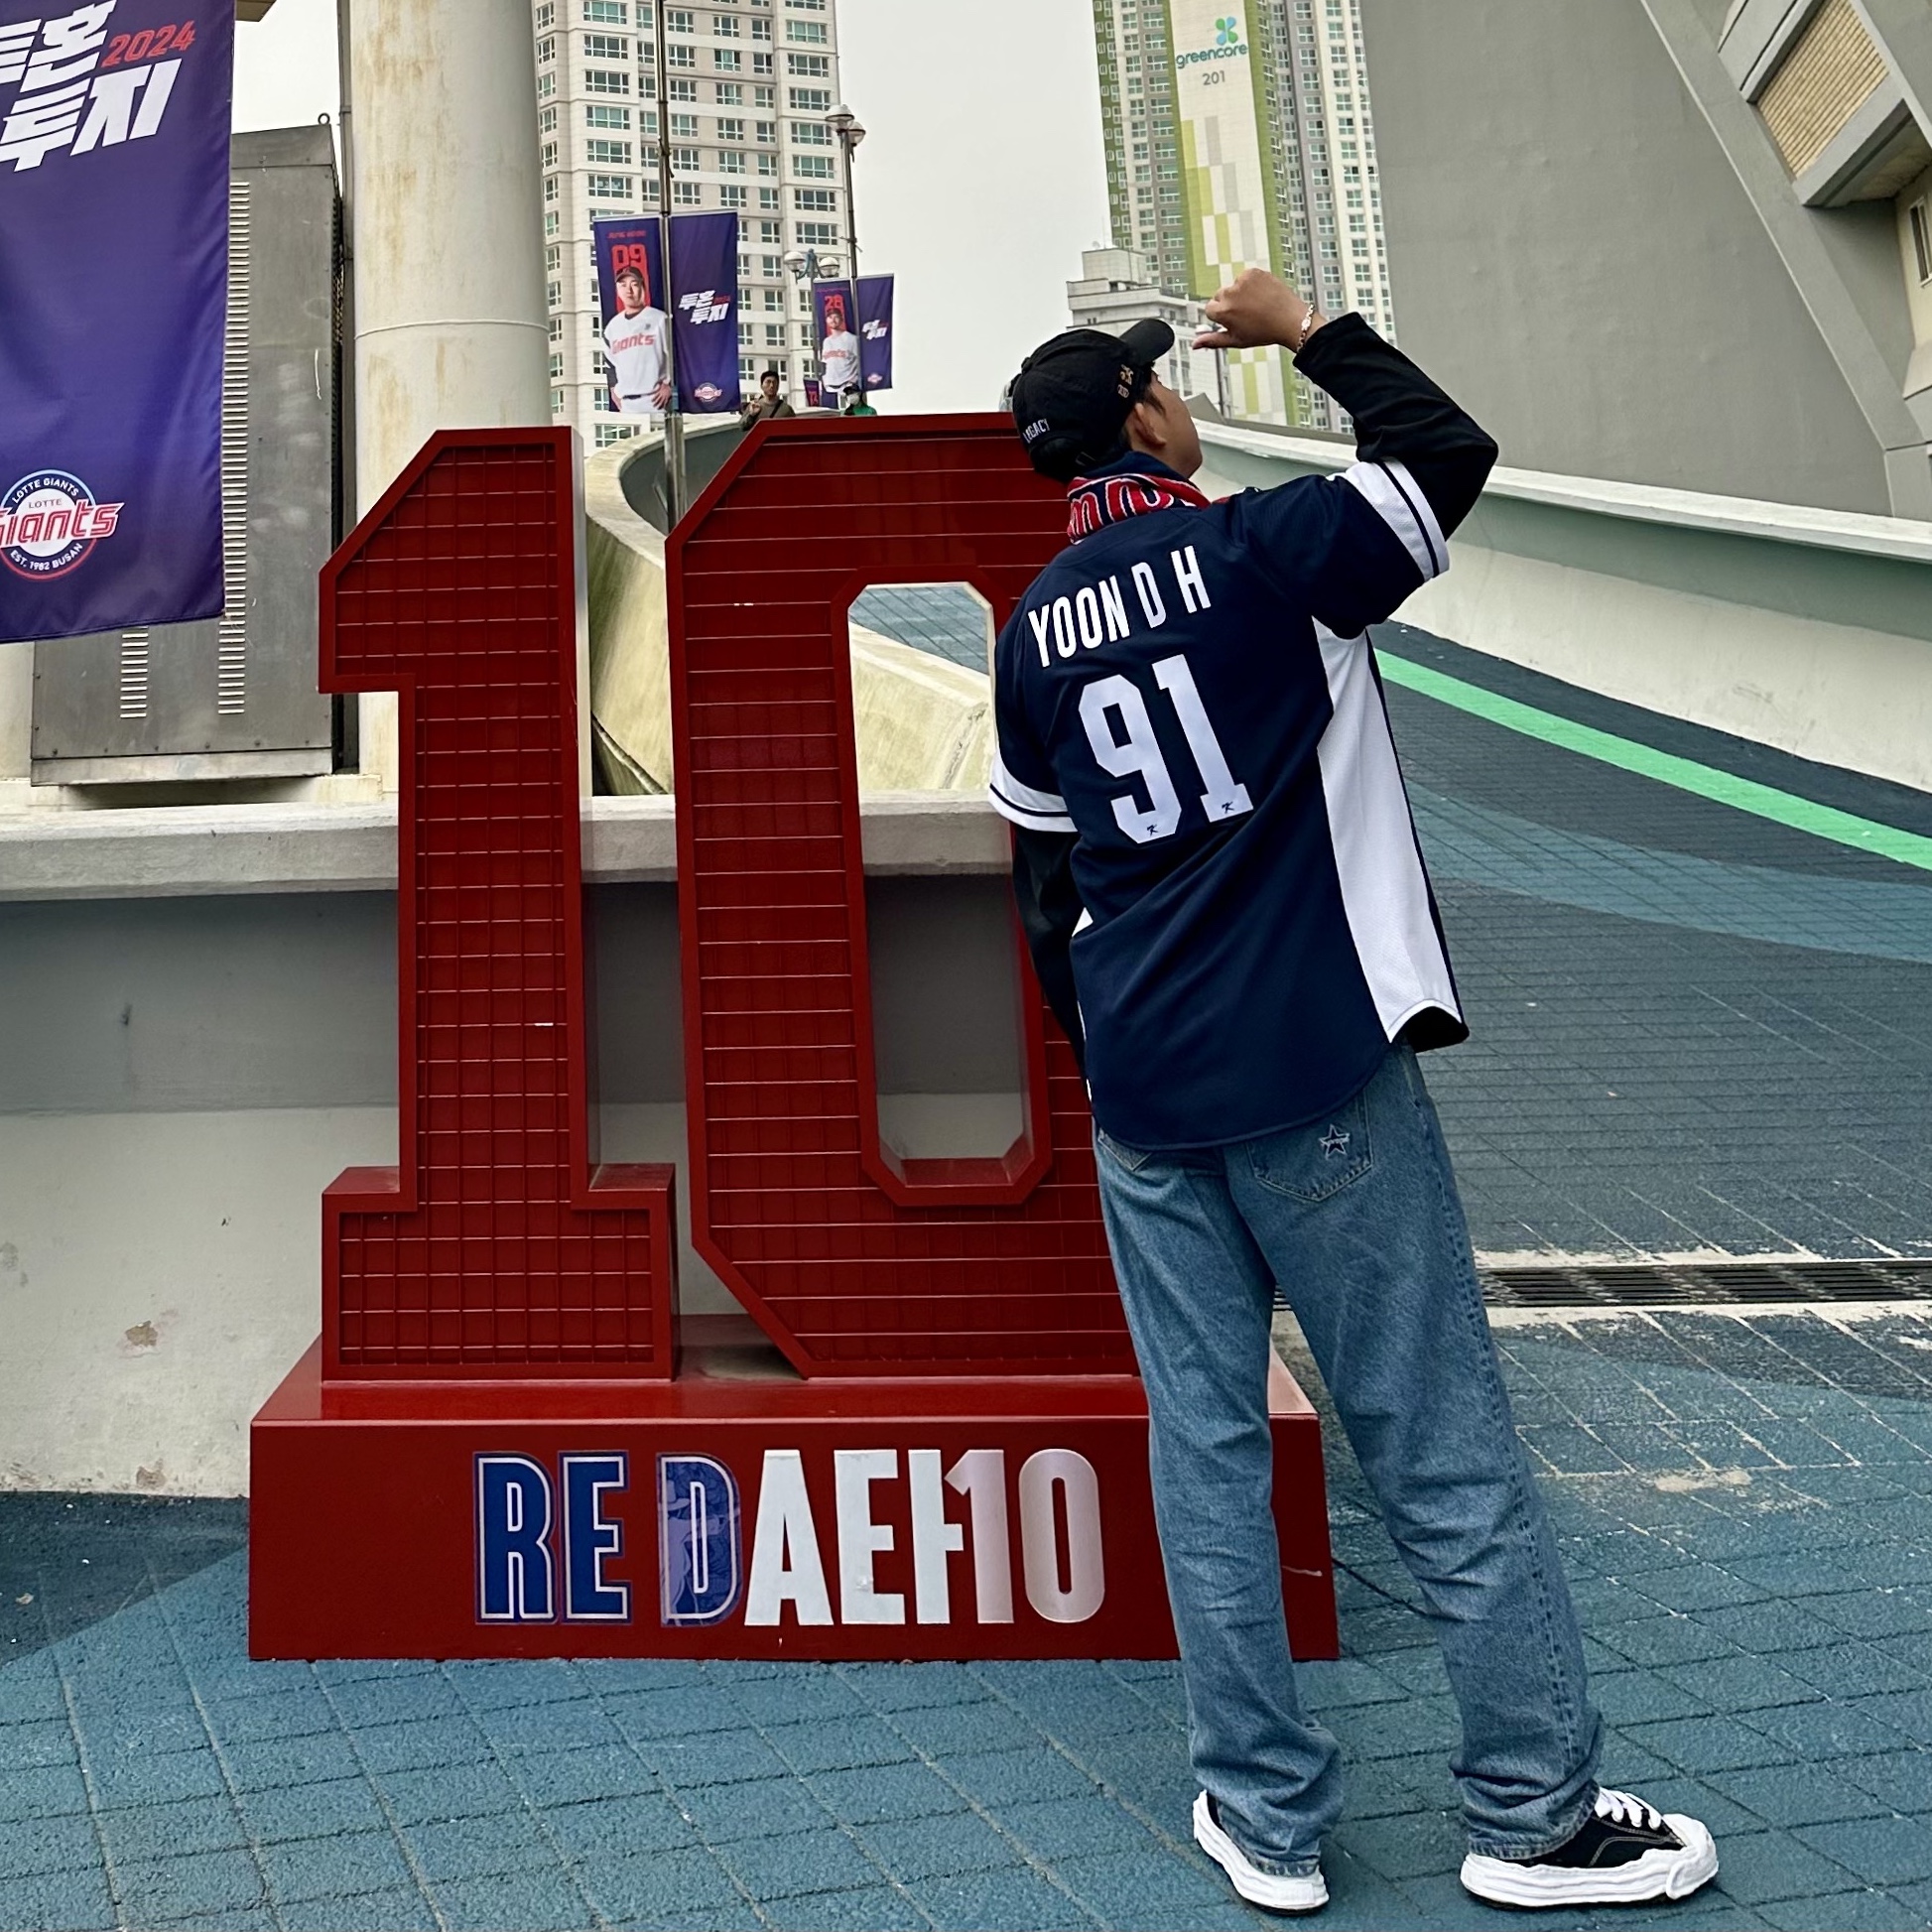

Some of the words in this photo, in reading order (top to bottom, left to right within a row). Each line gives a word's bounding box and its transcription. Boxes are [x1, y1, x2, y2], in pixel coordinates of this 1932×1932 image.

[101, 20, 195, 67] 2024
[1176, 45, 1247, 69] greencore
[1203, 70, 1225, 85] 201
[0, 59, 183, 173] 투지
[690, 303, 729, 324] 투지
[1022, 418, 1050, 444] LEGACY
[12, 478, 42, 504] LOTTE
[43, 478, 79, 496] GIANTS
[28, 499, 63, 509] LOTTE
[10, 549, 28, 569] EST.
[52, 543, 83, 569] BUSAN
[1028, 576, 1130, 668] YOON
[1131, 562, 1166, 628] D
[1171, 546, 1212, 613] H
[1079, 654, 1253, 843] 91
